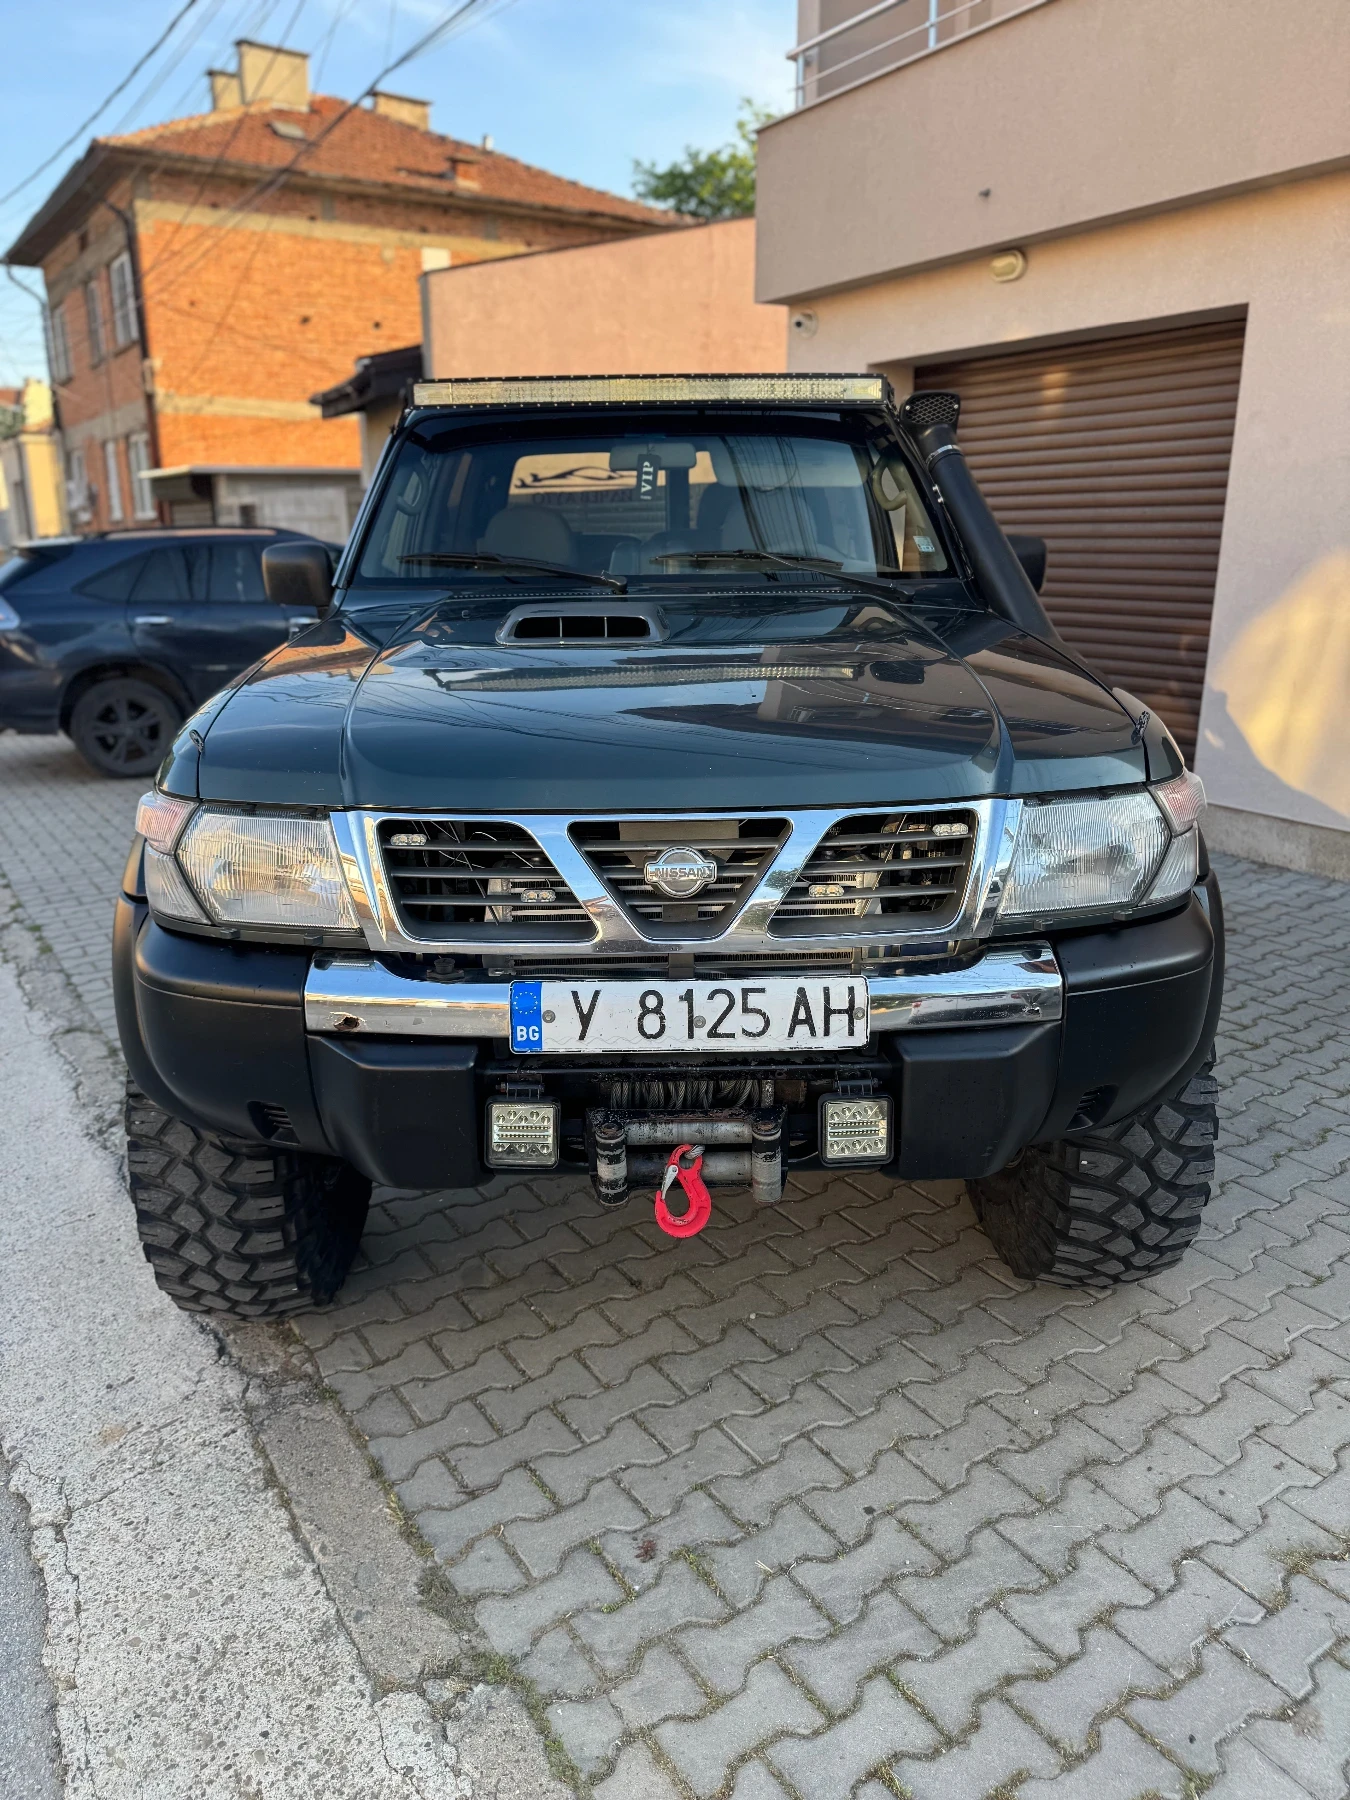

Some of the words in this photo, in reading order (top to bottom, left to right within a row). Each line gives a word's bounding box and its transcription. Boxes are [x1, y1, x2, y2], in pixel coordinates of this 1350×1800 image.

[640, 461, 653, 493] VIP
[655, 867, 704, 879] NISSAN
[637, 987, 771, 1040] 8125
[787, 986, 855, 1038] AH
[516, 1025, 540, 1042] BG
